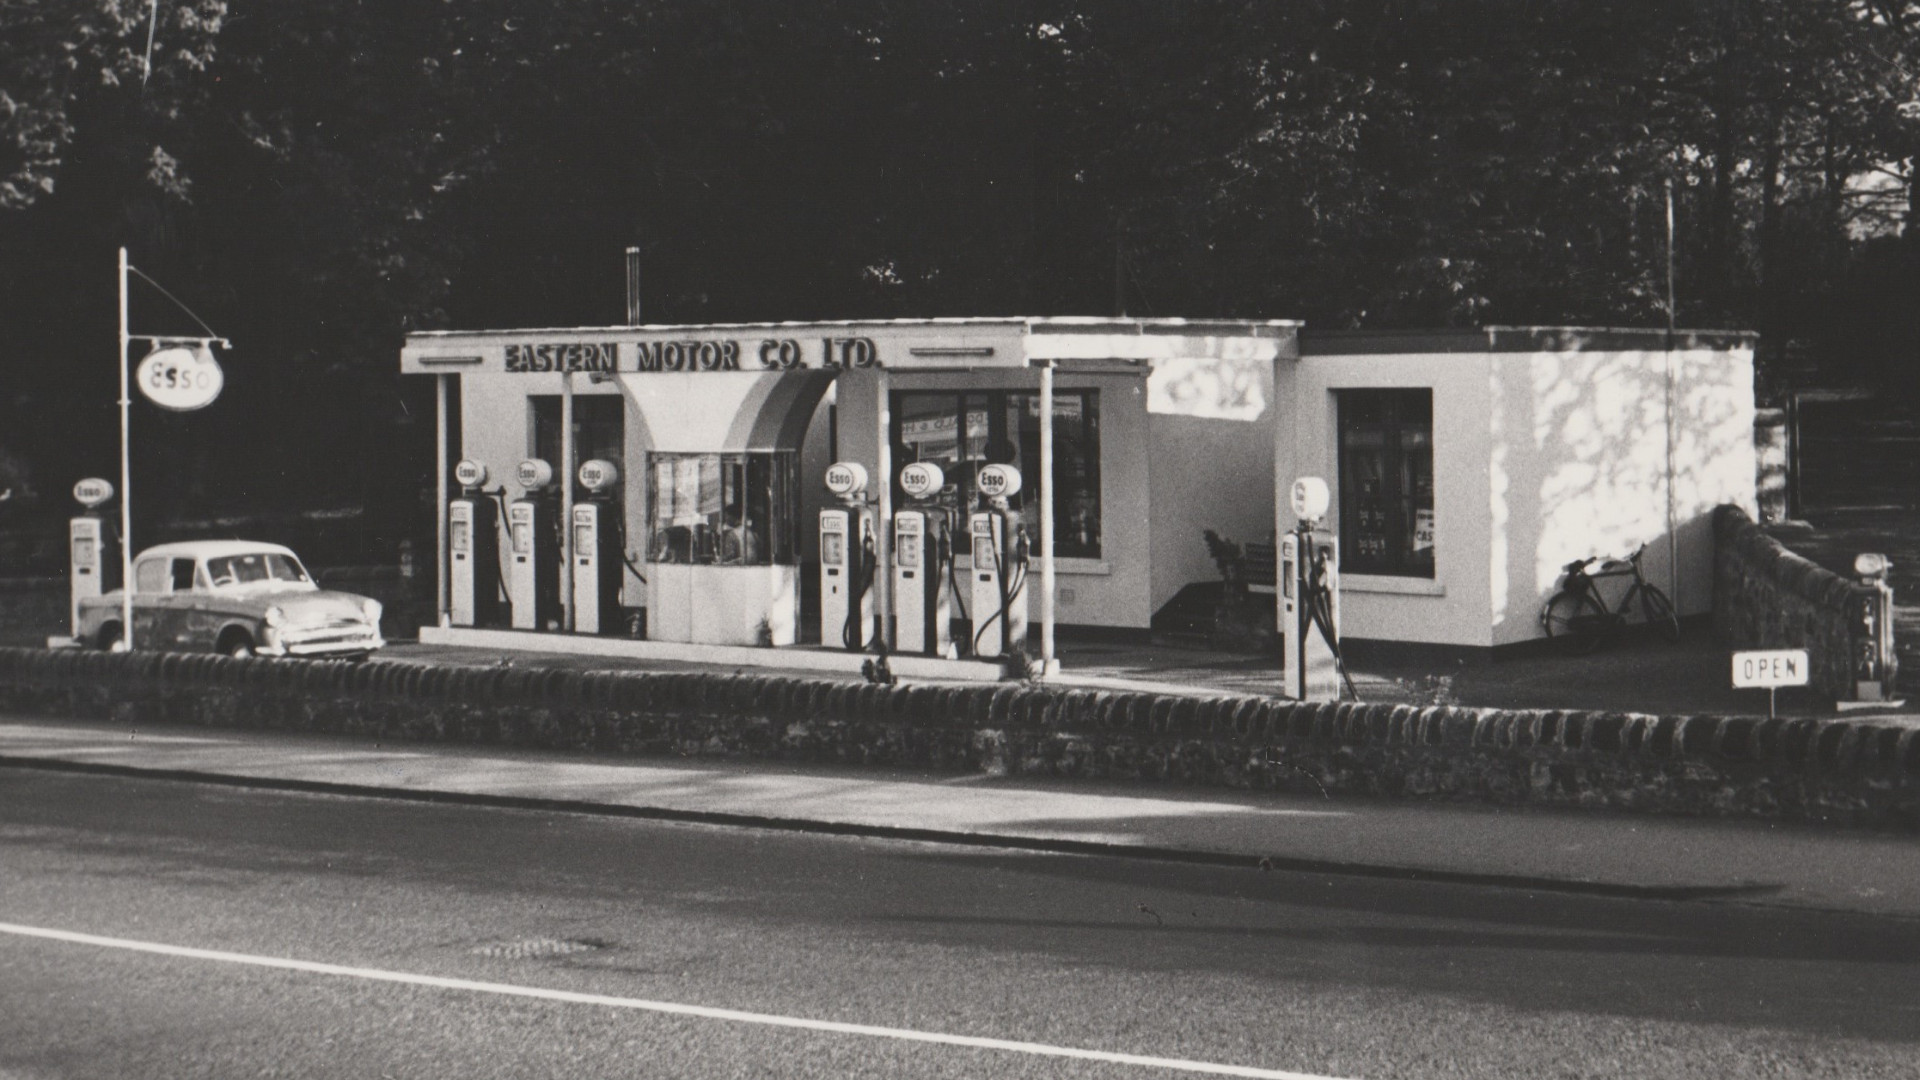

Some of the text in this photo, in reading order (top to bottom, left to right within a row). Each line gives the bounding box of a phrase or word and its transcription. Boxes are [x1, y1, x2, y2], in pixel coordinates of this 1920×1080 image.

[505, 343, 618, 373] EASTERN
[637, 340, 740, 372] MOTOR
[758, 338, 807, 370] CO.
[829, 471, 851, 485] Esso
[904, 471, 926, 485] Esso
[981, 472, 1004, 486] Esso
[1744, 658, 1796, 680] OPEN
